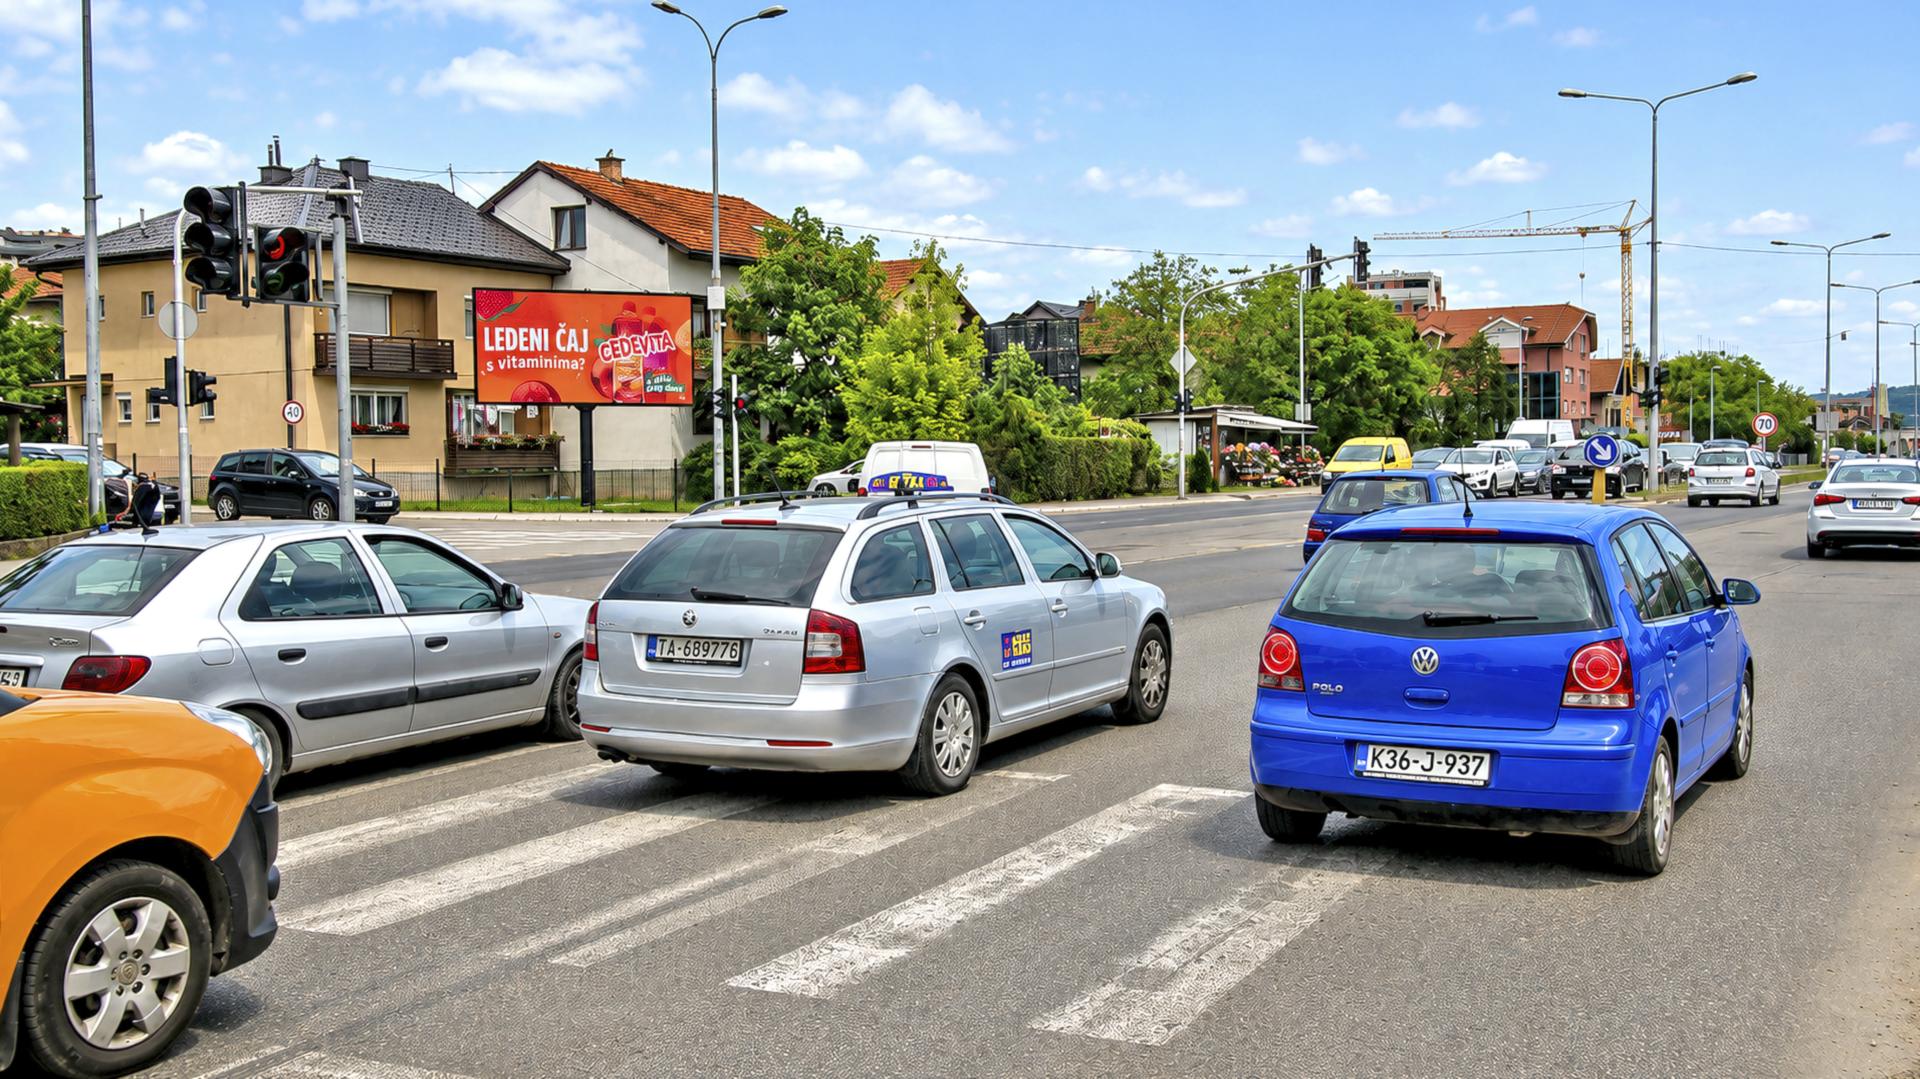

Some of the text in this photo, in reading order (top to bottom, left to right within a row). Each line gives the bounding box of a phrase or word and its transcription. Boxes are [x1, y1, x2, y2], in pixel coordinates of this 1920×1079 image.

[483, 322, 589, 353] LEDENI ČAJ
[598, 330, 676, 363] CEDEVITA
[486, 355, 586, 372] s vitaminima?
[1758, 418, 1773, 430] 70
[658, 639, 739, 659] TA-689776
[1312, 682, 1344, 693] POLO
[1371, 747, 1485, 777] K36-J-937
